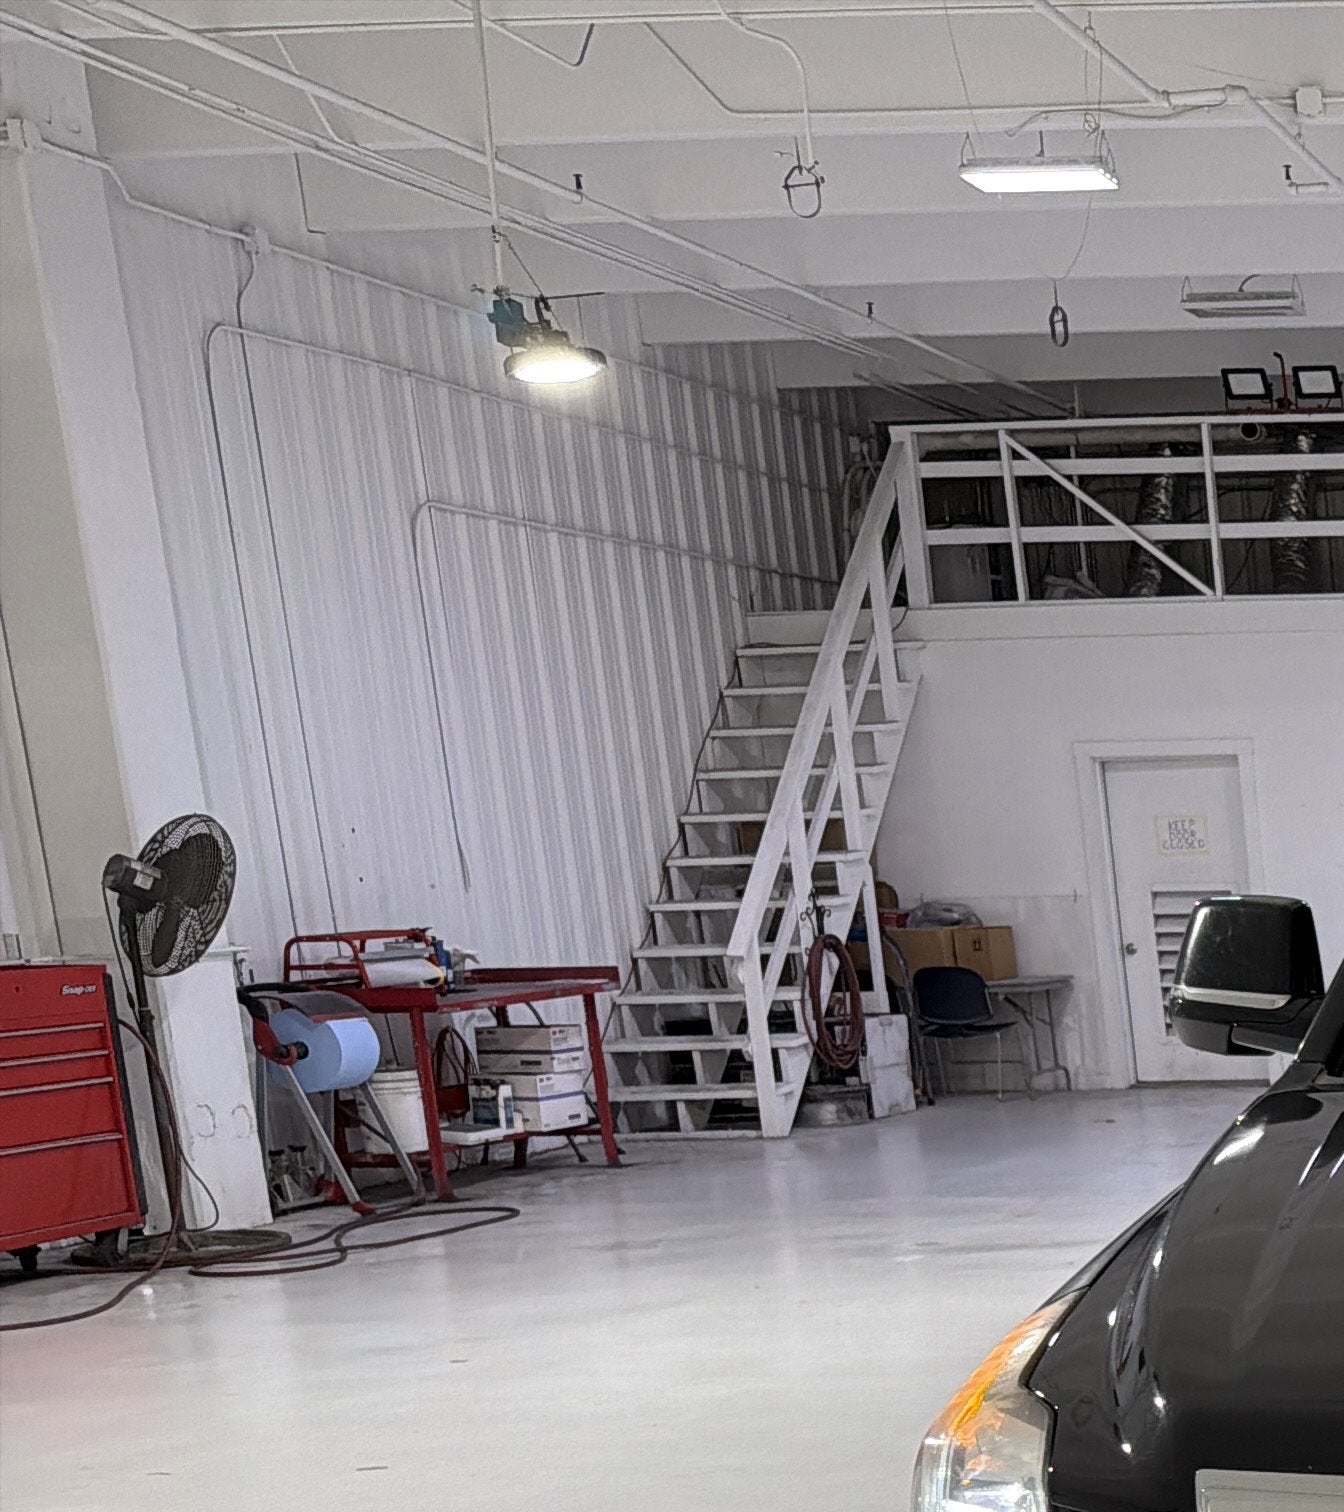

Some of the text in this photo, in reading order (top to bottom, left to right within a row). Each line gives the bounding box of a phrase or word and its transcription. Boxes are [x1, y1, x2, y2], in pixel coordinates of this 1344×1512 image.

[1168, 819, 1195, 831] KEEP
[1169, 830, 1197, 841] DOOR
[1162, 839, 1205, 850] CLOSED
